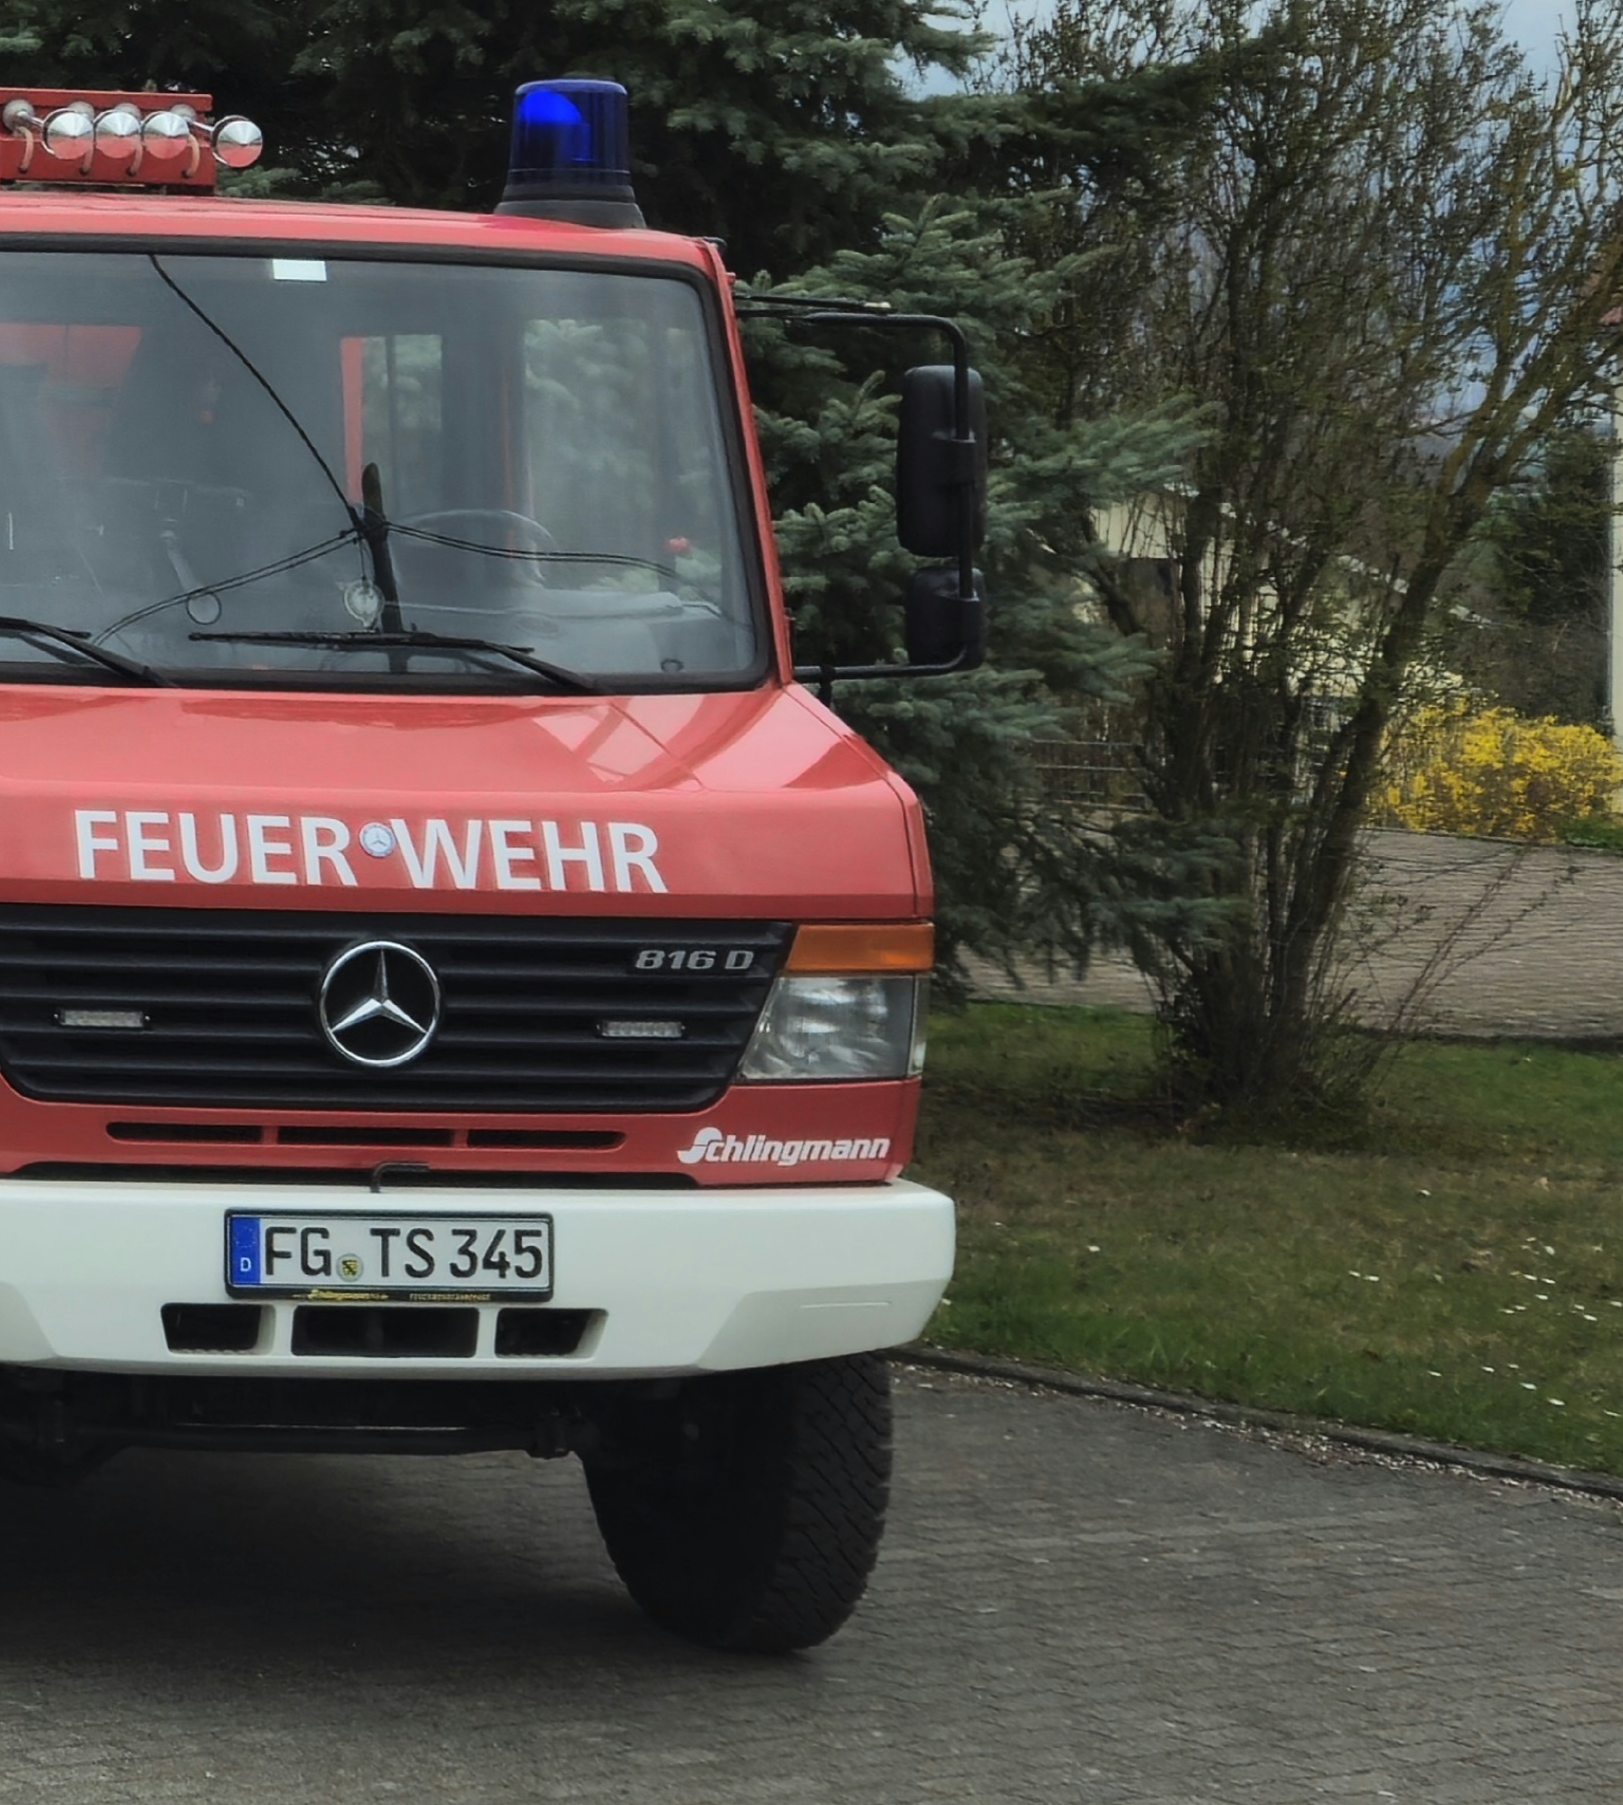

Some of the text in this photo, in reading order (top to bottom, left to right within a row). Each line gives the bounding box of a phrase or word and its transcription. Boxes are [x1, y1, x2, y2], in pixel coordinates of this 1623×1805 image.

[635, 950, 754, 970] 816 D
[677, 1126, 890, 1166] Schlingmann
[240, 1257, 252, 1272] D
[264, 1226, 543, 1278] FG TS 345
